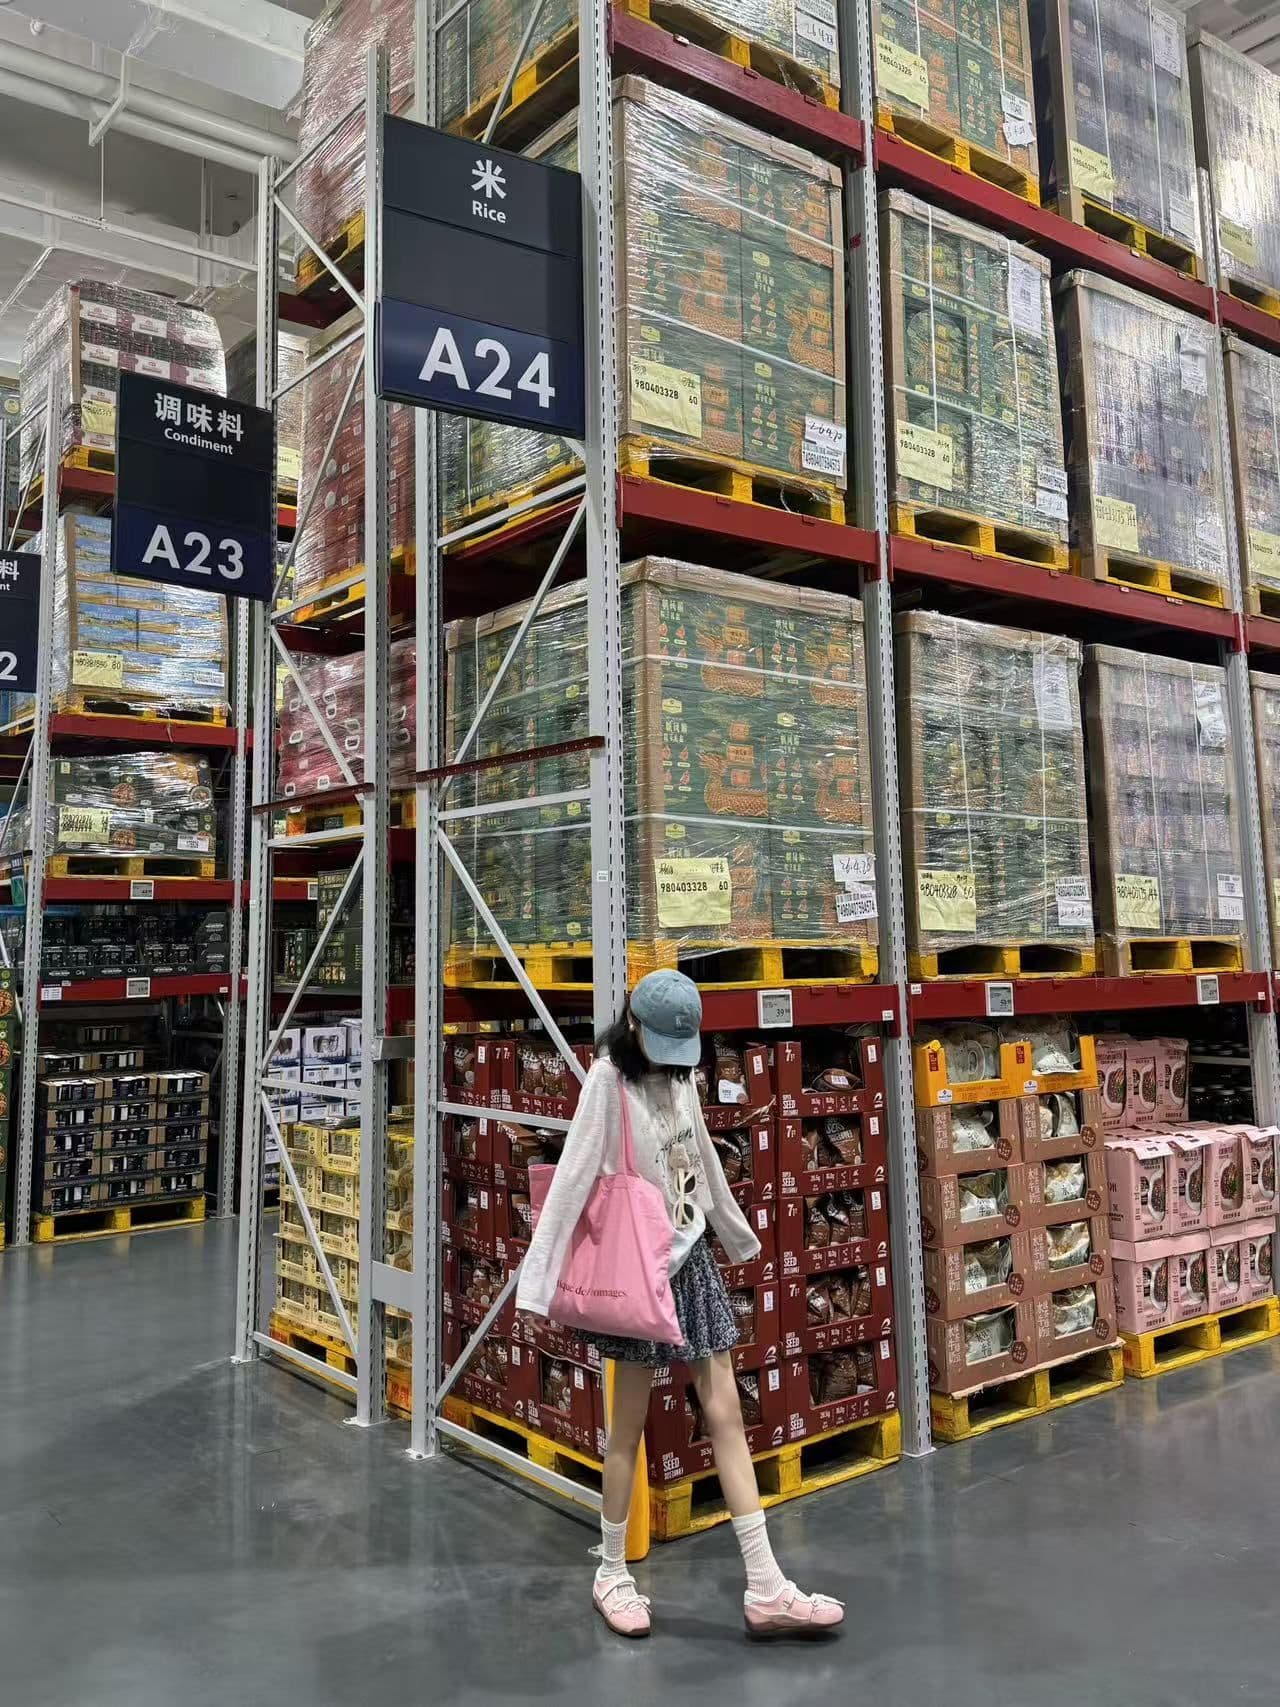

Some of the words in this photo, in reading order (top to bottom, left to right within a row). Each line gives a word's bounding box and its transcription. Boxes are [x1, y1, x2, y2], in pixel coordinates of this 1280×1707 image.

[471, 159, 507, 199] 米
[472, 200, 506, 224] Rice
[418, 326, 556, 409] A24
[635, 378, 679, 400] 980403328
[688, 395, 698, 405] 60
[154, 392, 244, 442] 调味料
[164, 427, 233, 455] Condiment
[900, 439, 935, 458] 980403328
[942, 454, 950, 463] 60
[141, 524, 244, 580] A23
[660, 881, 708, 893] 980403328
[718, 881, 728, 891] 60
[782, 1100, 796, 1109] SEED
[782, 1177, 796, 1187] SEED
[787, 1203, 794, 1217] 7
[784, 1256, 797, 1267] SEED
[789, 1284, 797, 1297] 7
[786, 1337, 800, 1349] SEED
[654, 1367, 670, 1378] EED
[792, 1362, 799, 1377] 7
[663, 1395, 672, 1411] 7
[790, 1418, 804, 1431] SEED
[663, 1457, 680, 1472] SEED
